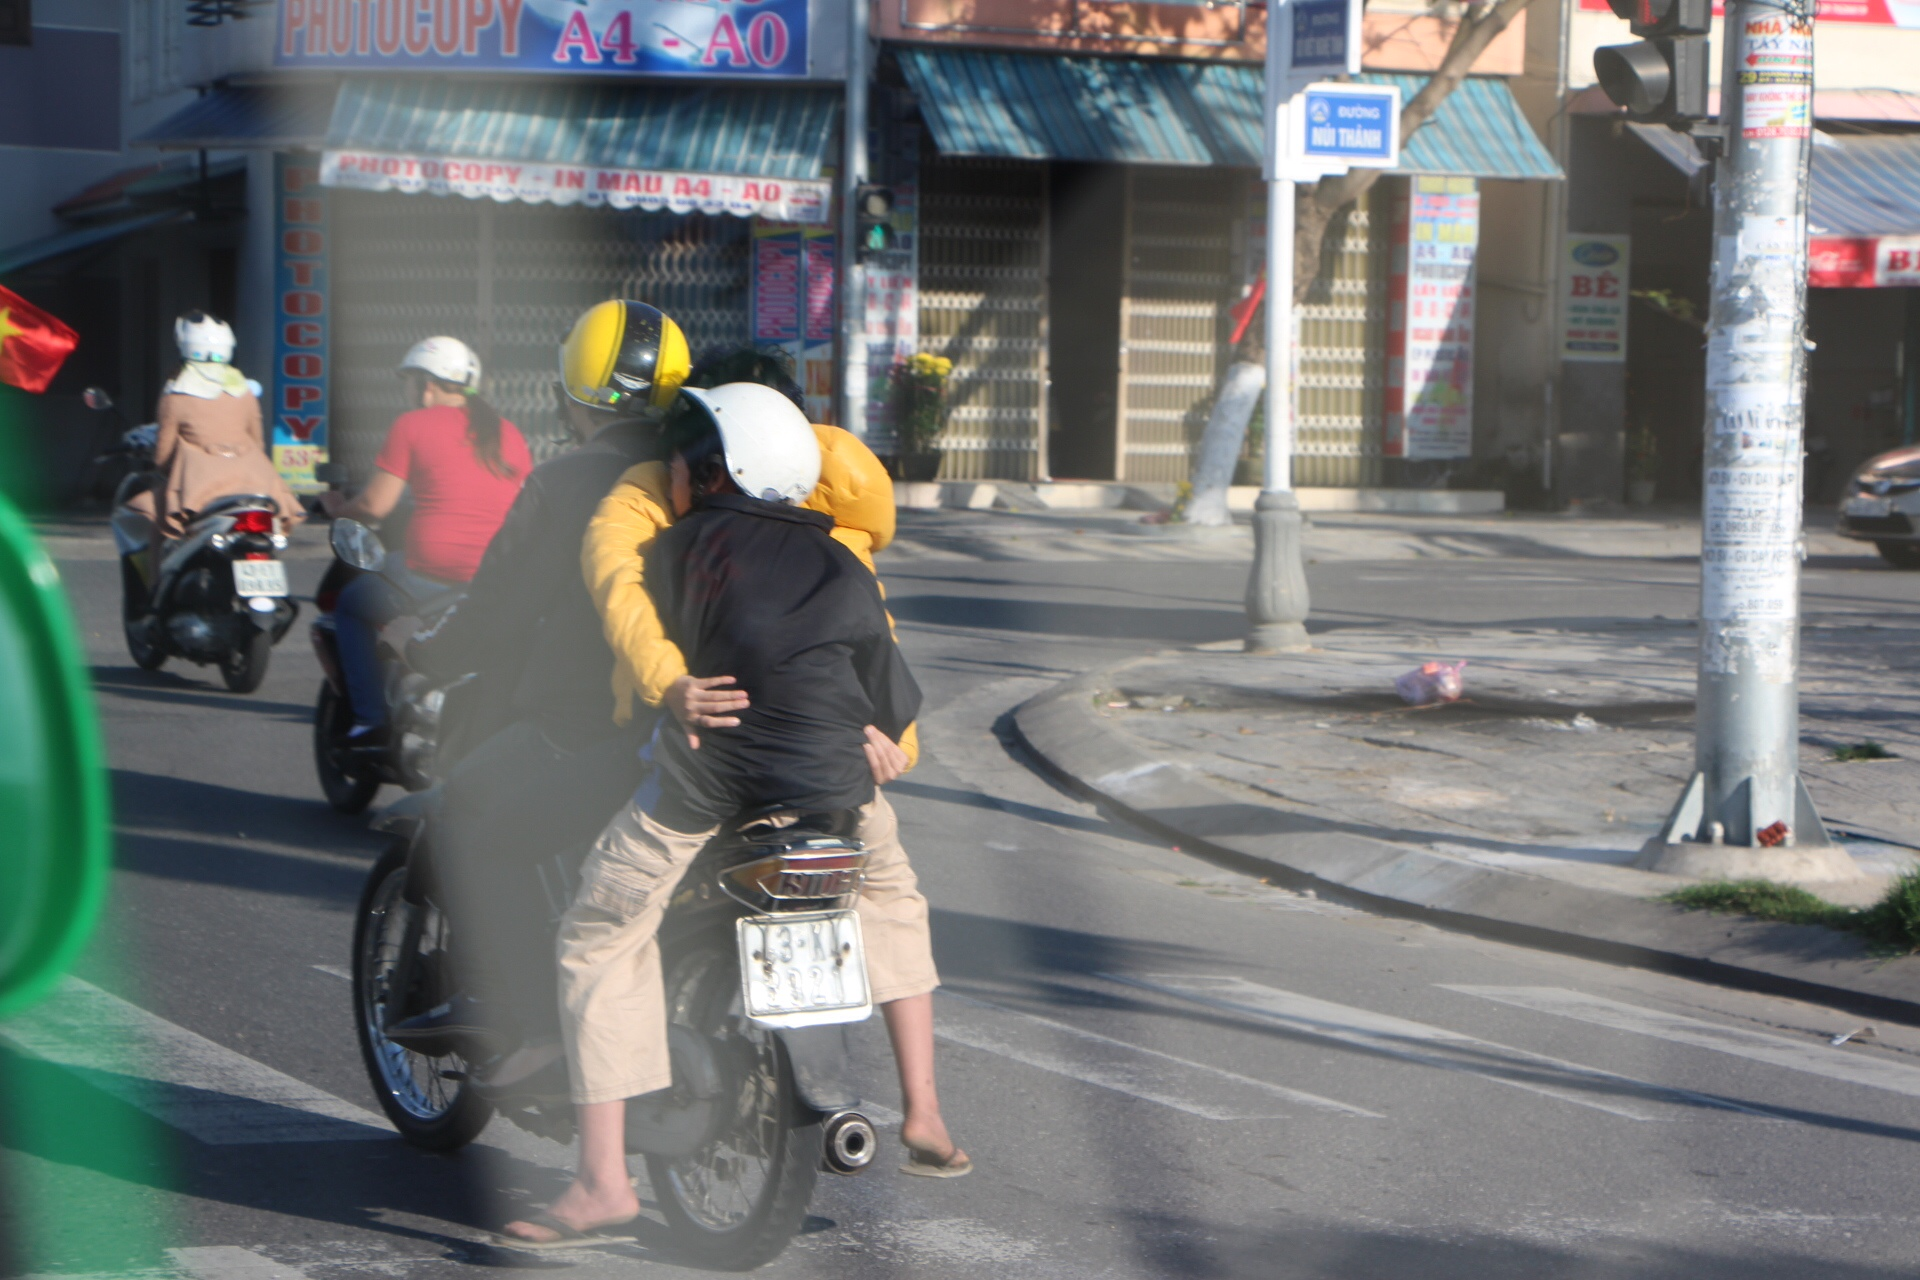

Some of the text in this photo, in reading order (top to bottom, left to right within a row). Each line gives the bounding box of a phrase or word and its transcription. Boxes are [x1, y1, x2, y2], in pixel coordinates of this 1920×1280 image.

[282, 0, 523, 56] PHOTOCOPY
[553, 10, 637, 63] A4
[702, 12, 788, 68] A0
[1312, 123, 1382, 149] NÚI THÀNH
[1338, 104, 1381, 119] ĐƯỜNG
[338, 154, 523, 185] PHOTOCOPY
[554, 168, 586, 189] IN
[597, 170, 663, 194] MÀU
[673, 176, 711, 197] A4
[742, 181, 783, 203] A0
[283, 166, 323, 440] PHOTOCOPY
[757, 239, 798, 340] PHOTOCOPY
[806, 238, 834, 340] PHOTOCOPY
